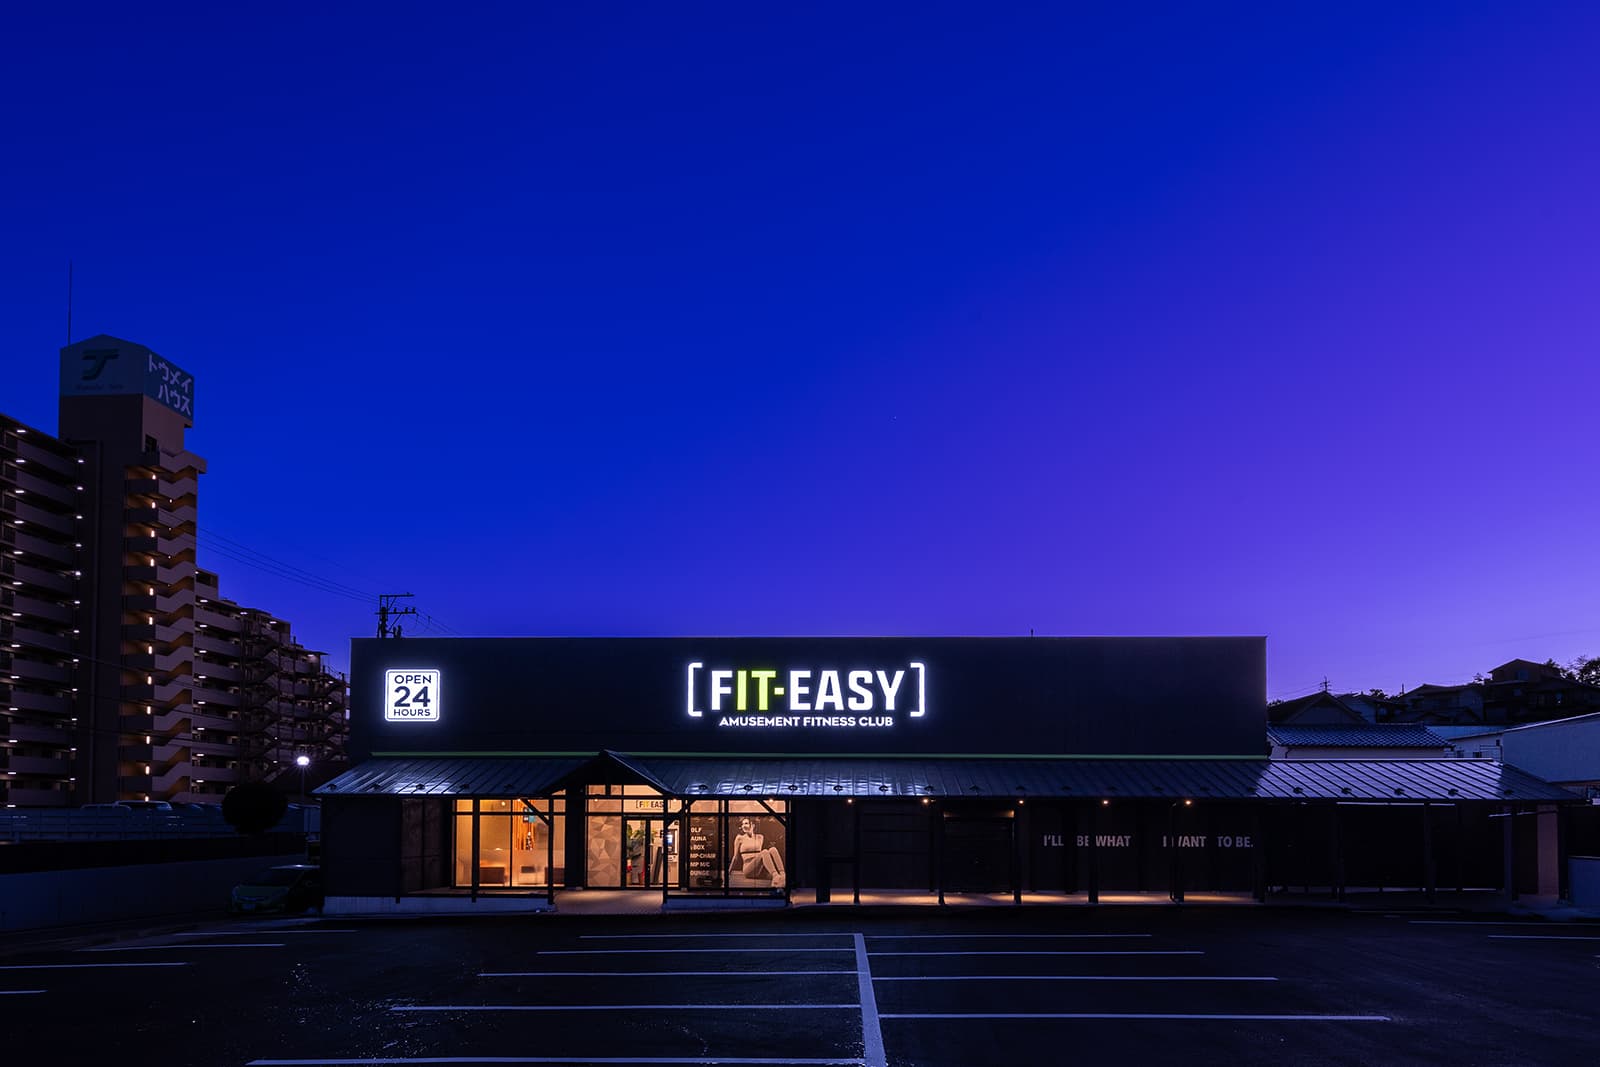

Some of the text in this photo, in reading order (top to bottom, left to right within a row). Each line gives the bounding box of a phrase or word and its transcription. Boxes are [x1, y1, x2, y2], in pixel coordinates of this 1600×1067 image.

[148, 352, 193, 394] トウメイ
[157, 382, 193, 416] ハウス
[394, 675, 431, 684] OPEN
[394, 685, 430, 707] 24
[393, 708, 430, 717] HOURS
[719, 716, 894, 727] AMUSEMENT FITNESS CLUB
[1043, 834, 1065, 848] I'LL
[1095, 834, 1132, 848] WHAT
[1216, 834, 1232, 848] TO
[1235, 834, 1254, 848] BE.
